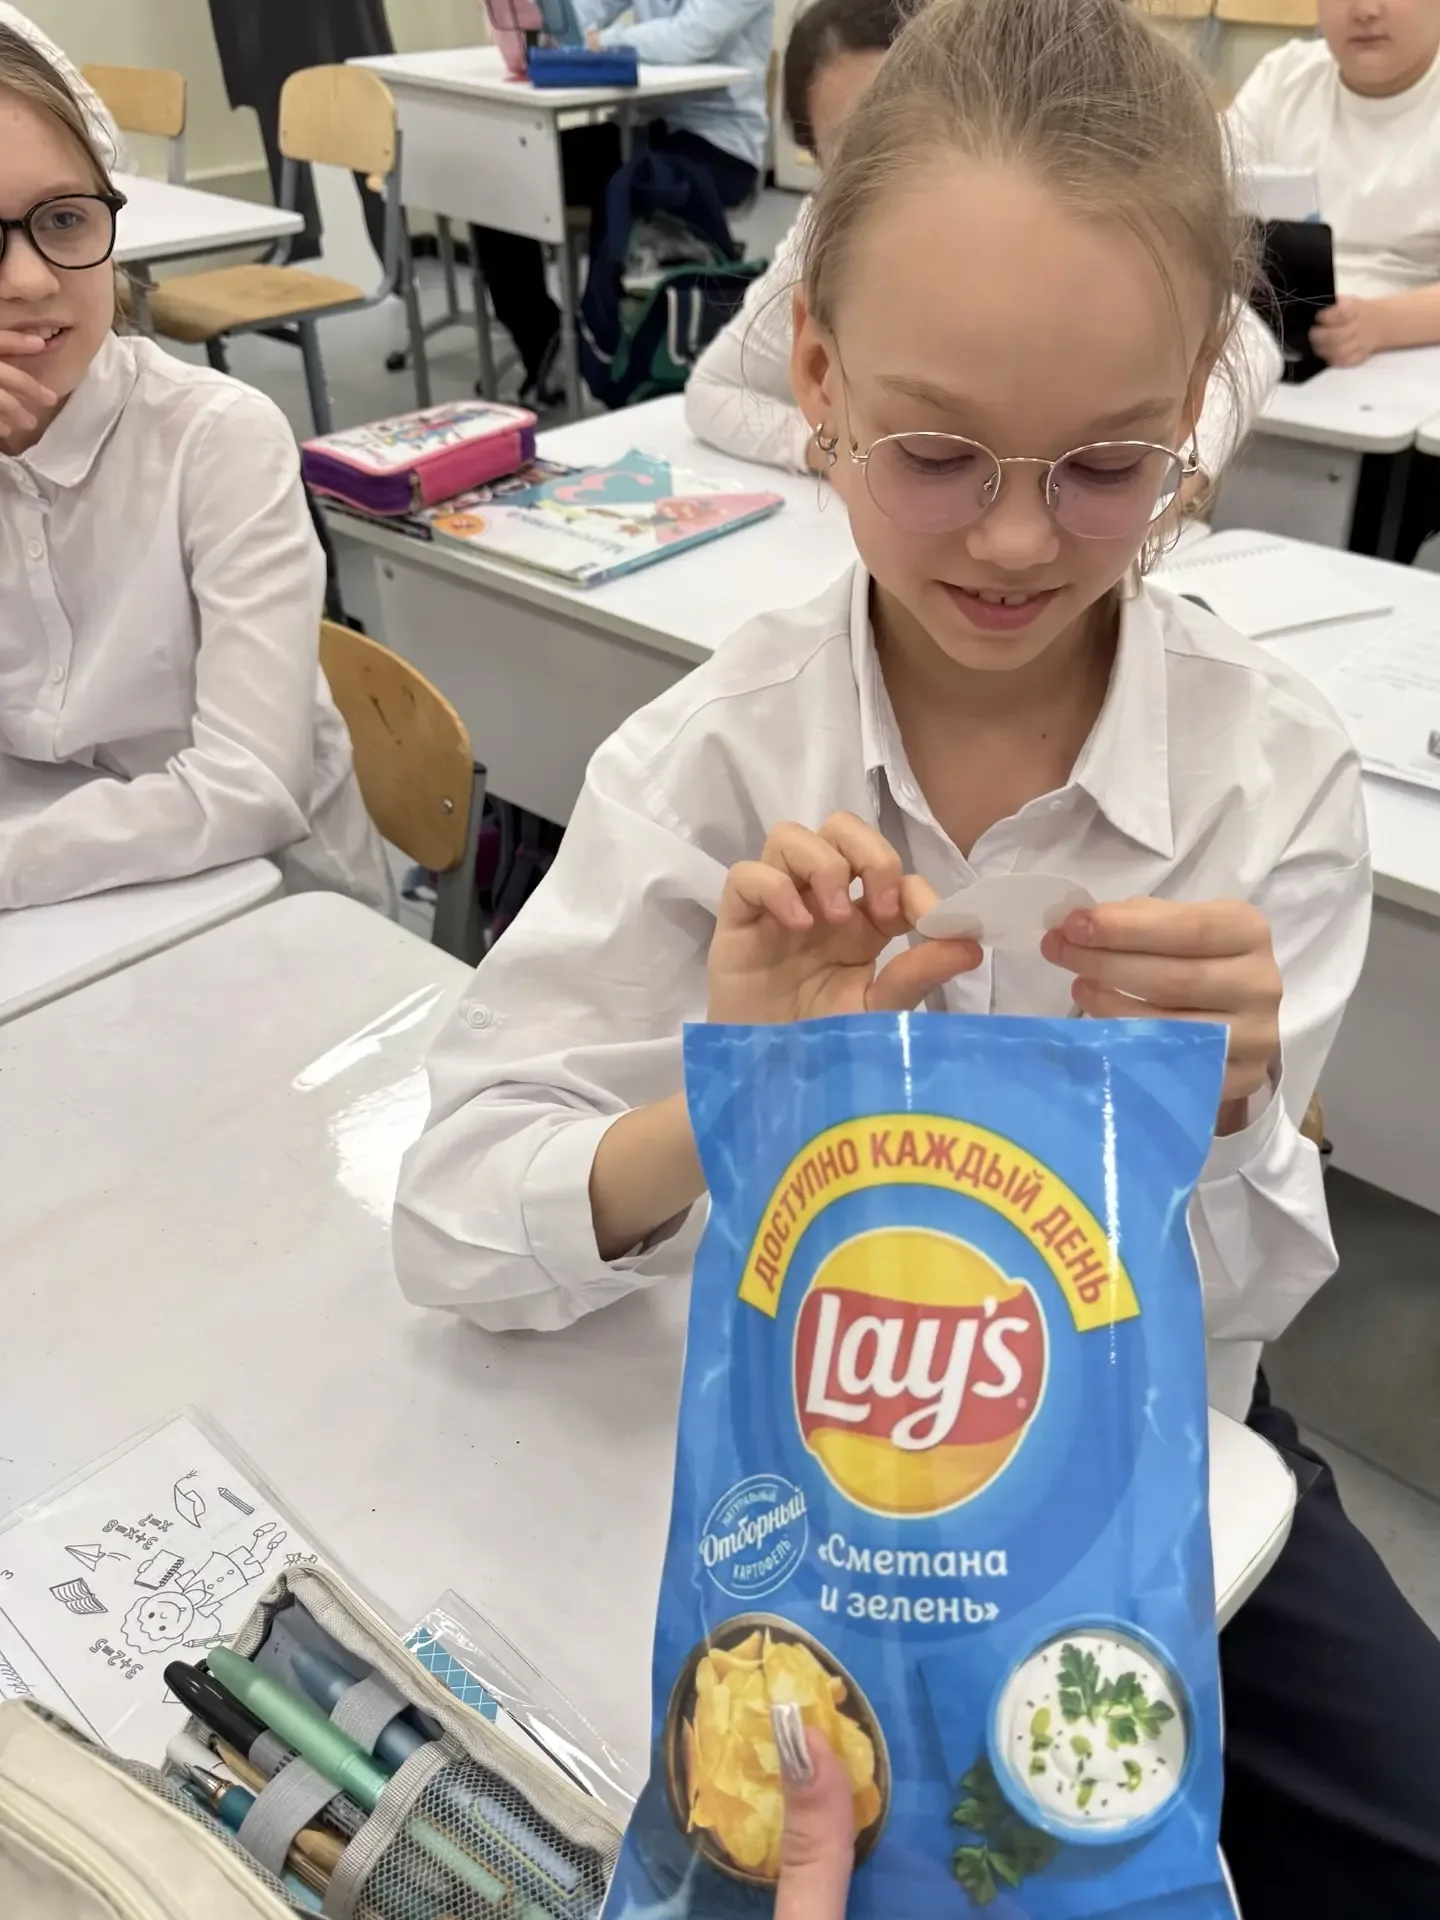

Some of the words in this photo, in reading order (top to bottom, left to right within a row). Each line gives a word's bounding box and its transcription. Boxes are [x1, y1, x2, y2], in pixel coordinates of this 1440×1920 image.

[755, 1137, 858, 1292] ДОСТУПНО
[870, 1129, 1045, 1214] КАЖДЫЙ
[1031, 1203, 1110, 1305] ДЕНЬ
[805, 1293, 1030, 1450] Lay's
[699, 1486, 806, 1567] Отборный
[817, 1533, 1008, 1577] «Сметана
[820, 1584, 838, 1613] и
[846, 1592, 999, 1624] зелень»
[89, 1638, 144, 1680] 3+2=5
